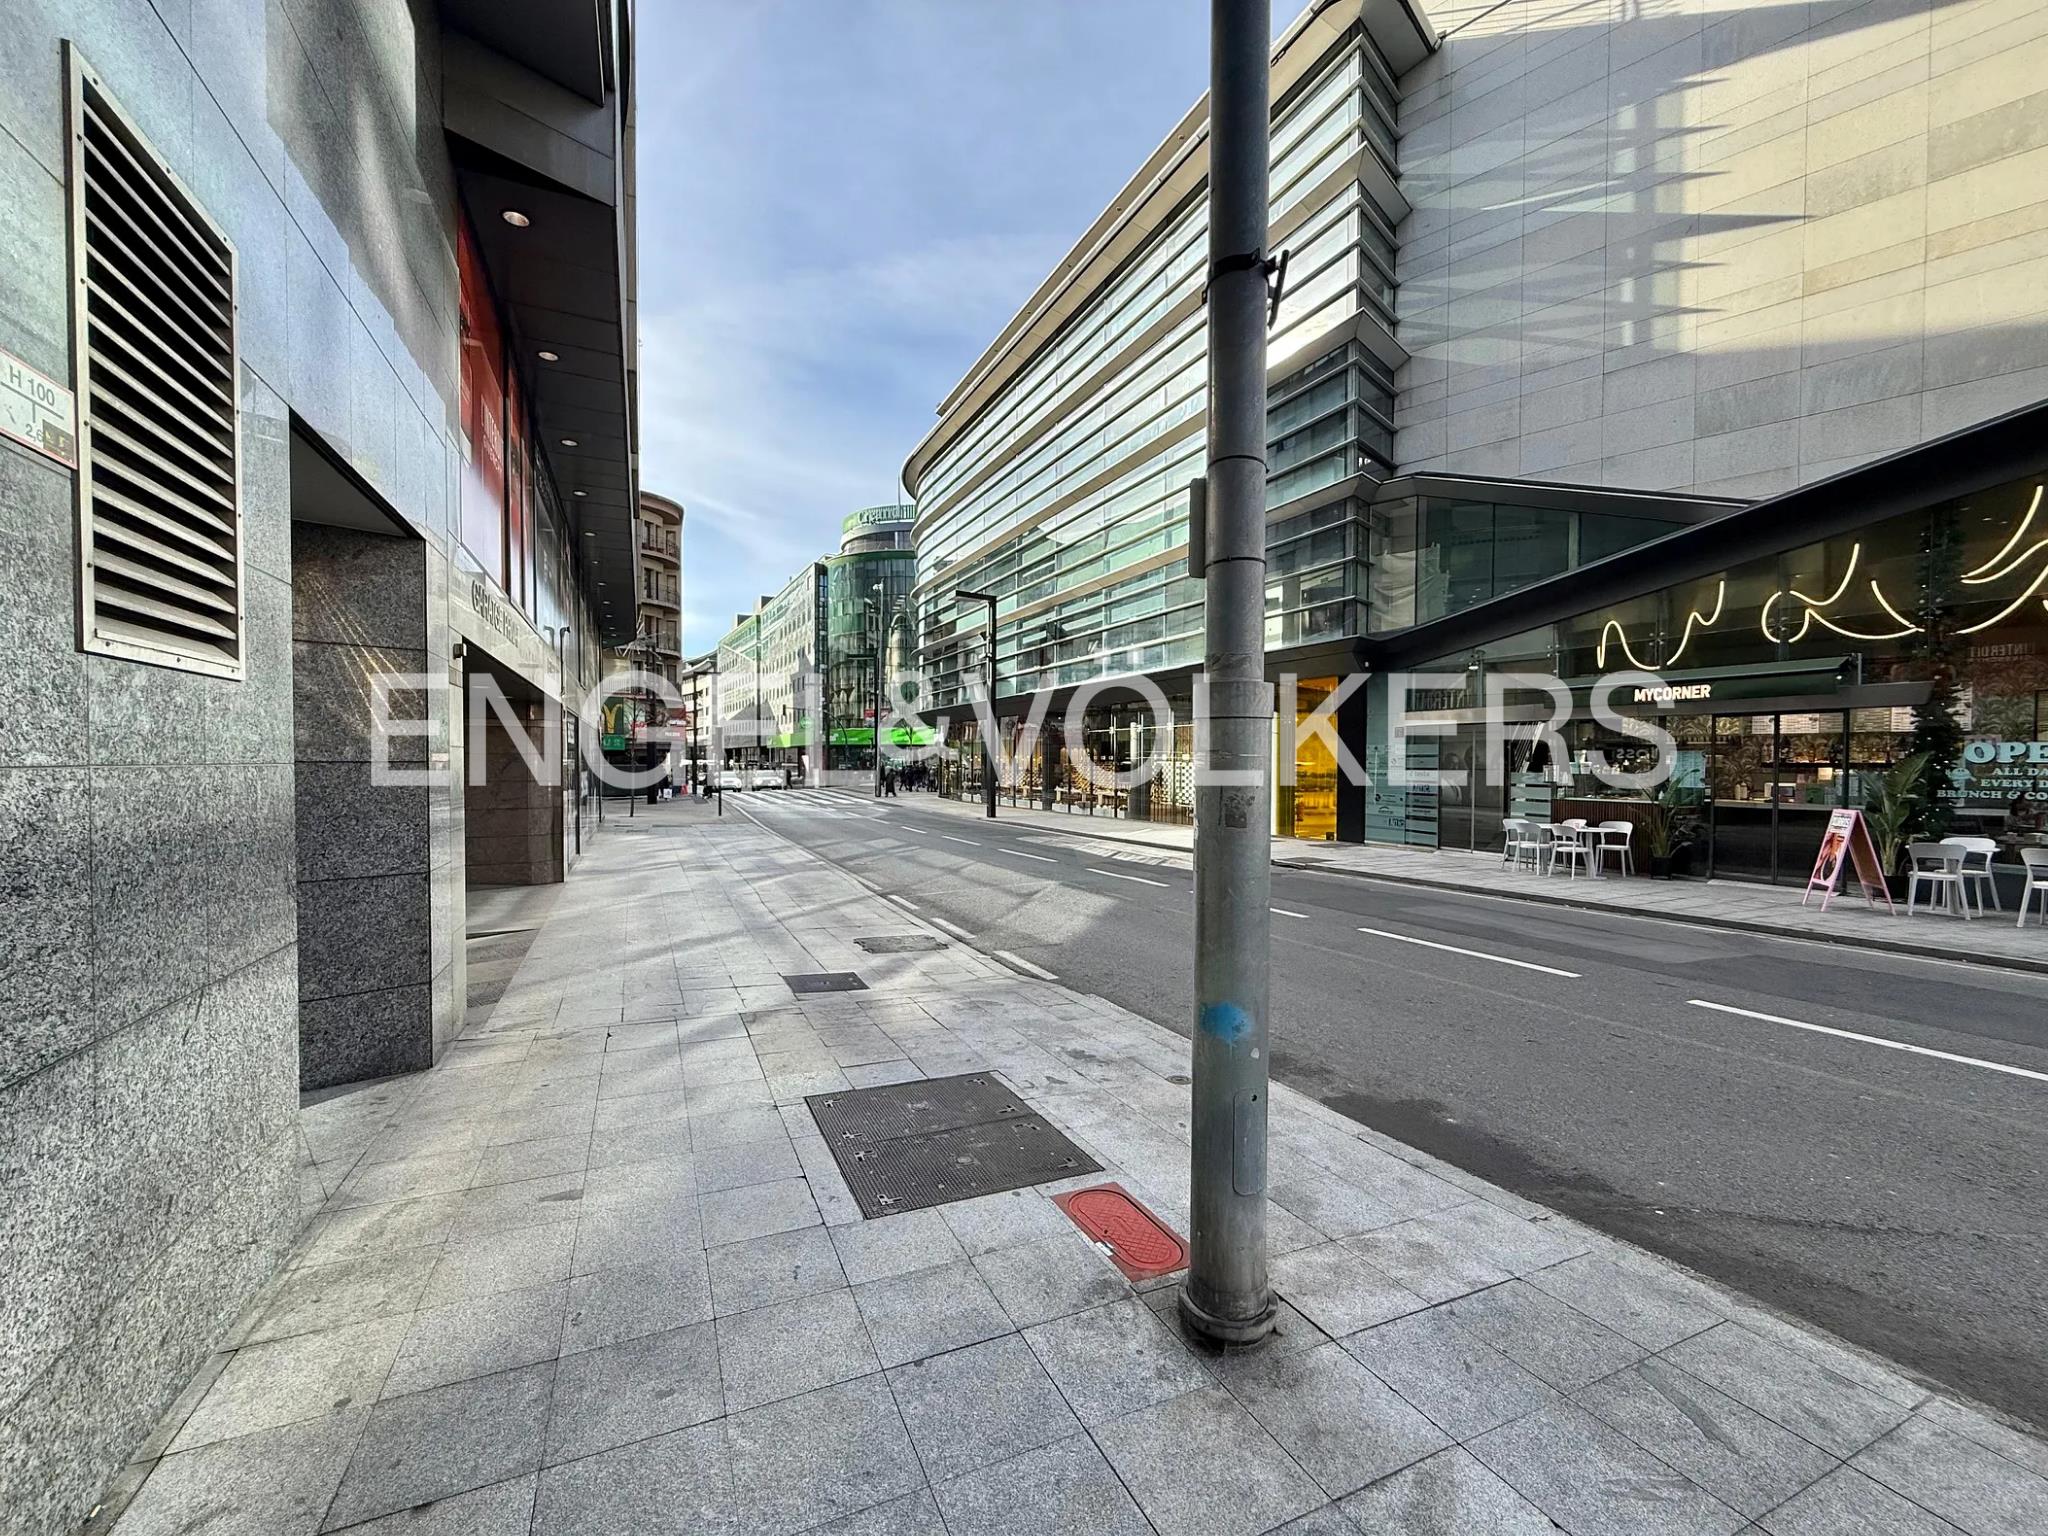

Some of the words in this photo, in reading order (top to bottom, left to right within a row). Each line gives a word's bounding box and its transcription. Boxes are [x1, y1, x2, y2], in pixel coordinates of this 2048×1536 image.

[9, 364, 22, 388] H
[28, 378, 55, 407] 100
[1634, 684, 1711, 702] MYCORNER
[1992, 767, 2023, 776] ALL
[1980, 779, 2034, 788] EVERY
[1936, 789, 2002, 798] BRUNCH
[2007, 790, 2021, 799] &
